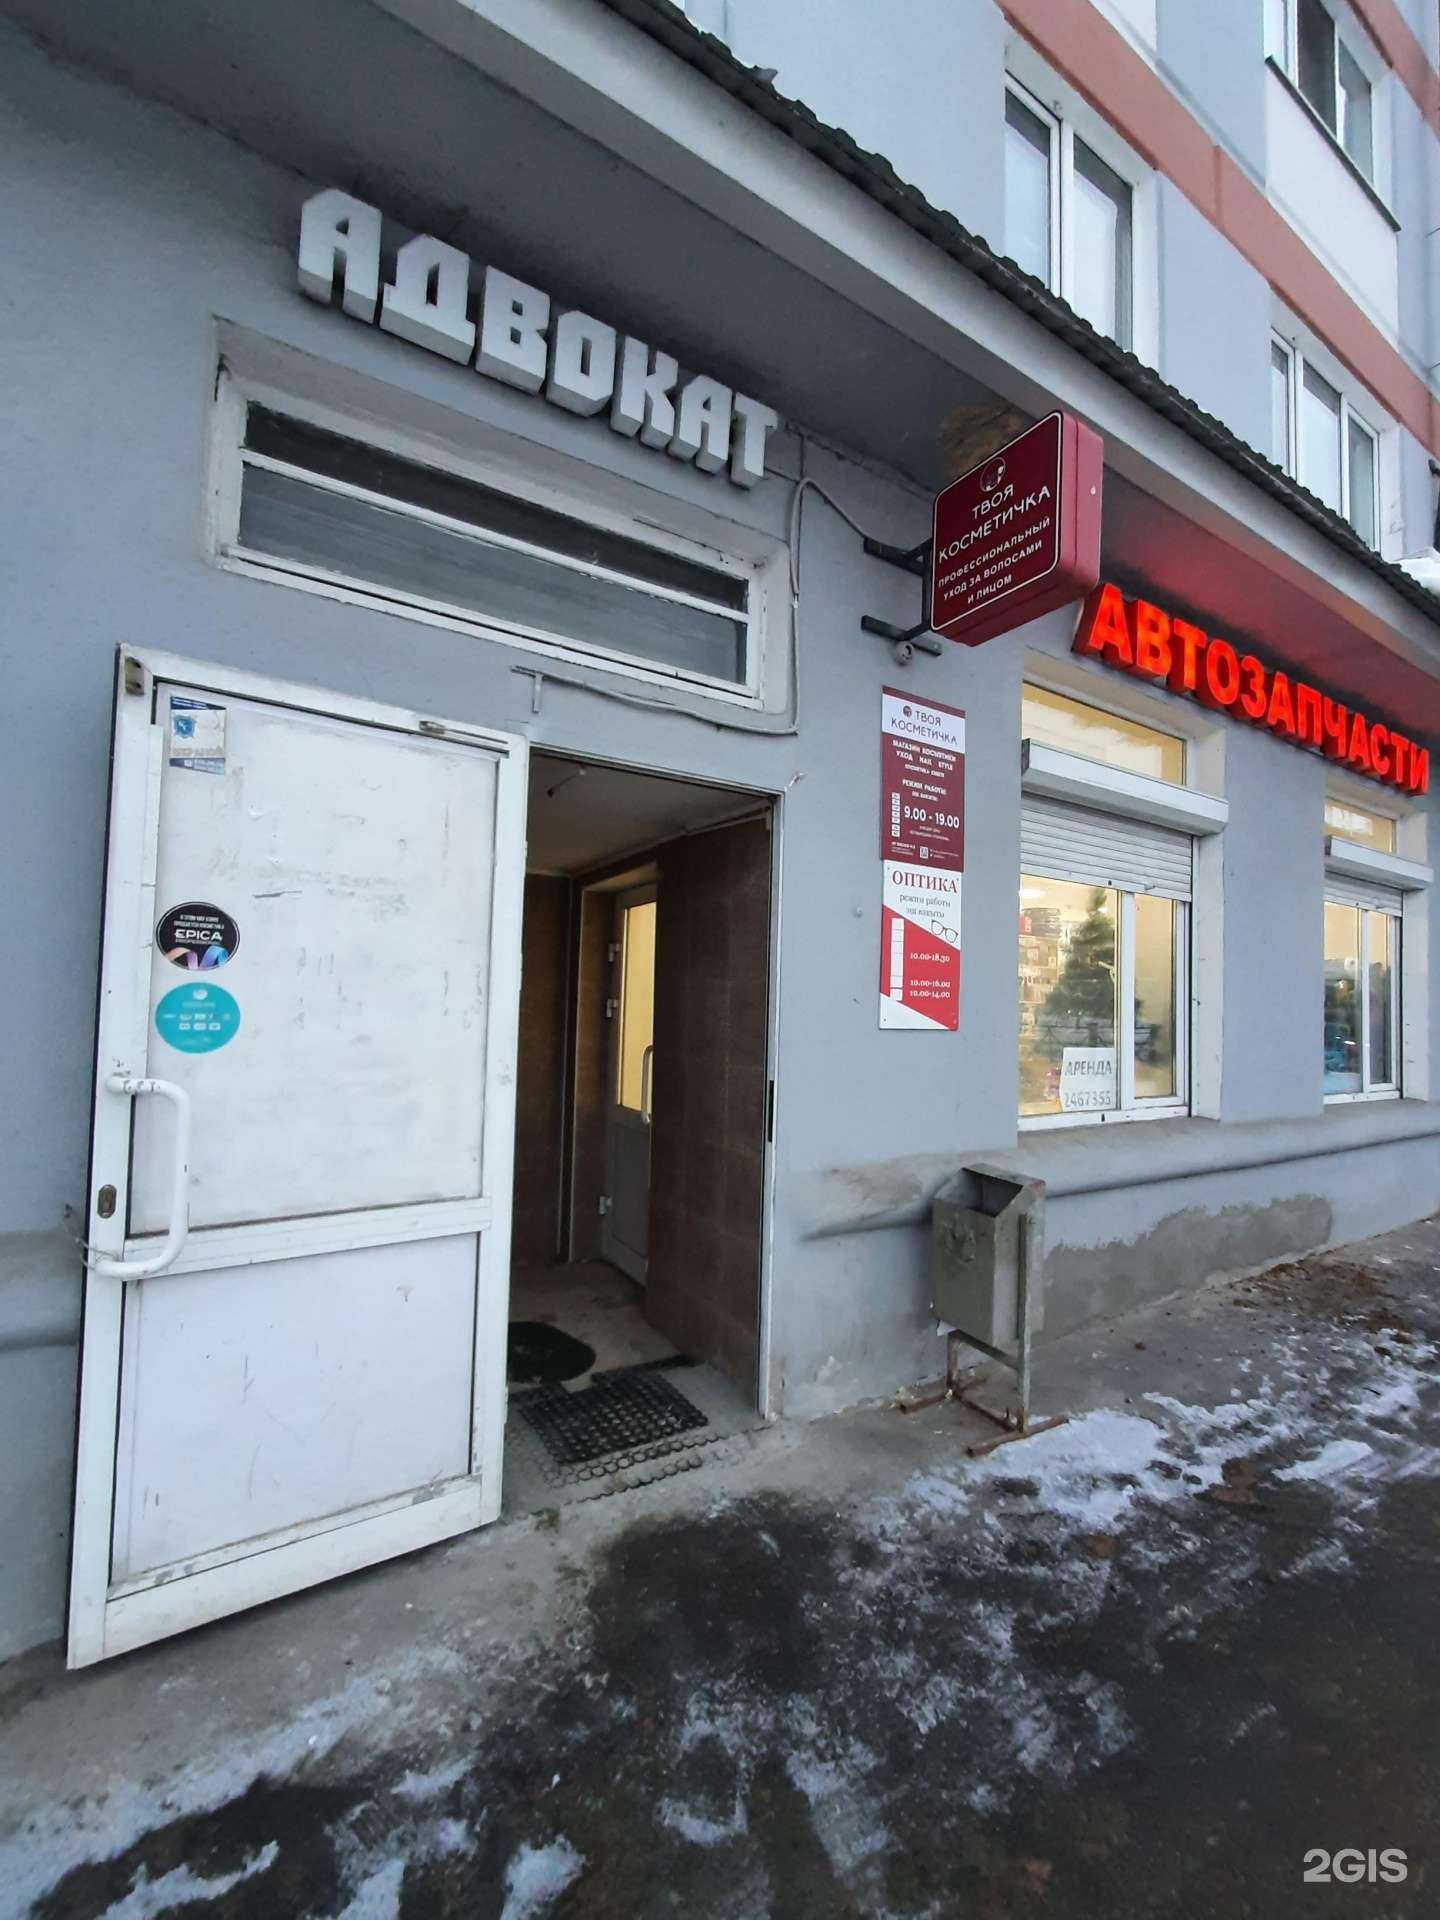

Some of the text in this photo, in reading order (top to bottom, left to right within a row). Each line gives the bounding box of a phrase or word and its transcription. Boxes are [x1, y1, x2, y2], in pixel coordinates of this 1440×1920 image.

[299, 188, 778, 490] АДВОКАТ
[972, 484, 1014, 519] ТВОЯ
[938, 485, 1051, 564] КОСМЕТИЧКА
[938, 516, 1050, 588] ПРОФЕССИОНАЛЬНЫЙ
[943, 539, 1042, 601] УХОД ЗА ВОЛОСАМИ
[967, 574, 1012, 604] И ЛИЦОМ
[1088, 582, 1430, 796] АВТОЗАПЧАСТИ
[891, 717, 958, 745] КОСМЕТИЧКА
[915, 710, 941, 726] ТВОЯ
[896, 750, 913, 761] УХОД
[904, 805, 927, 822] 9.00
[935, 812, 960, 829] 19.00
[892, 870, 958, 894] ОПТИКА
[174, 929, 223, 942] EPICA
[1064, 1060, 1113, 1077] АРЕНДА
